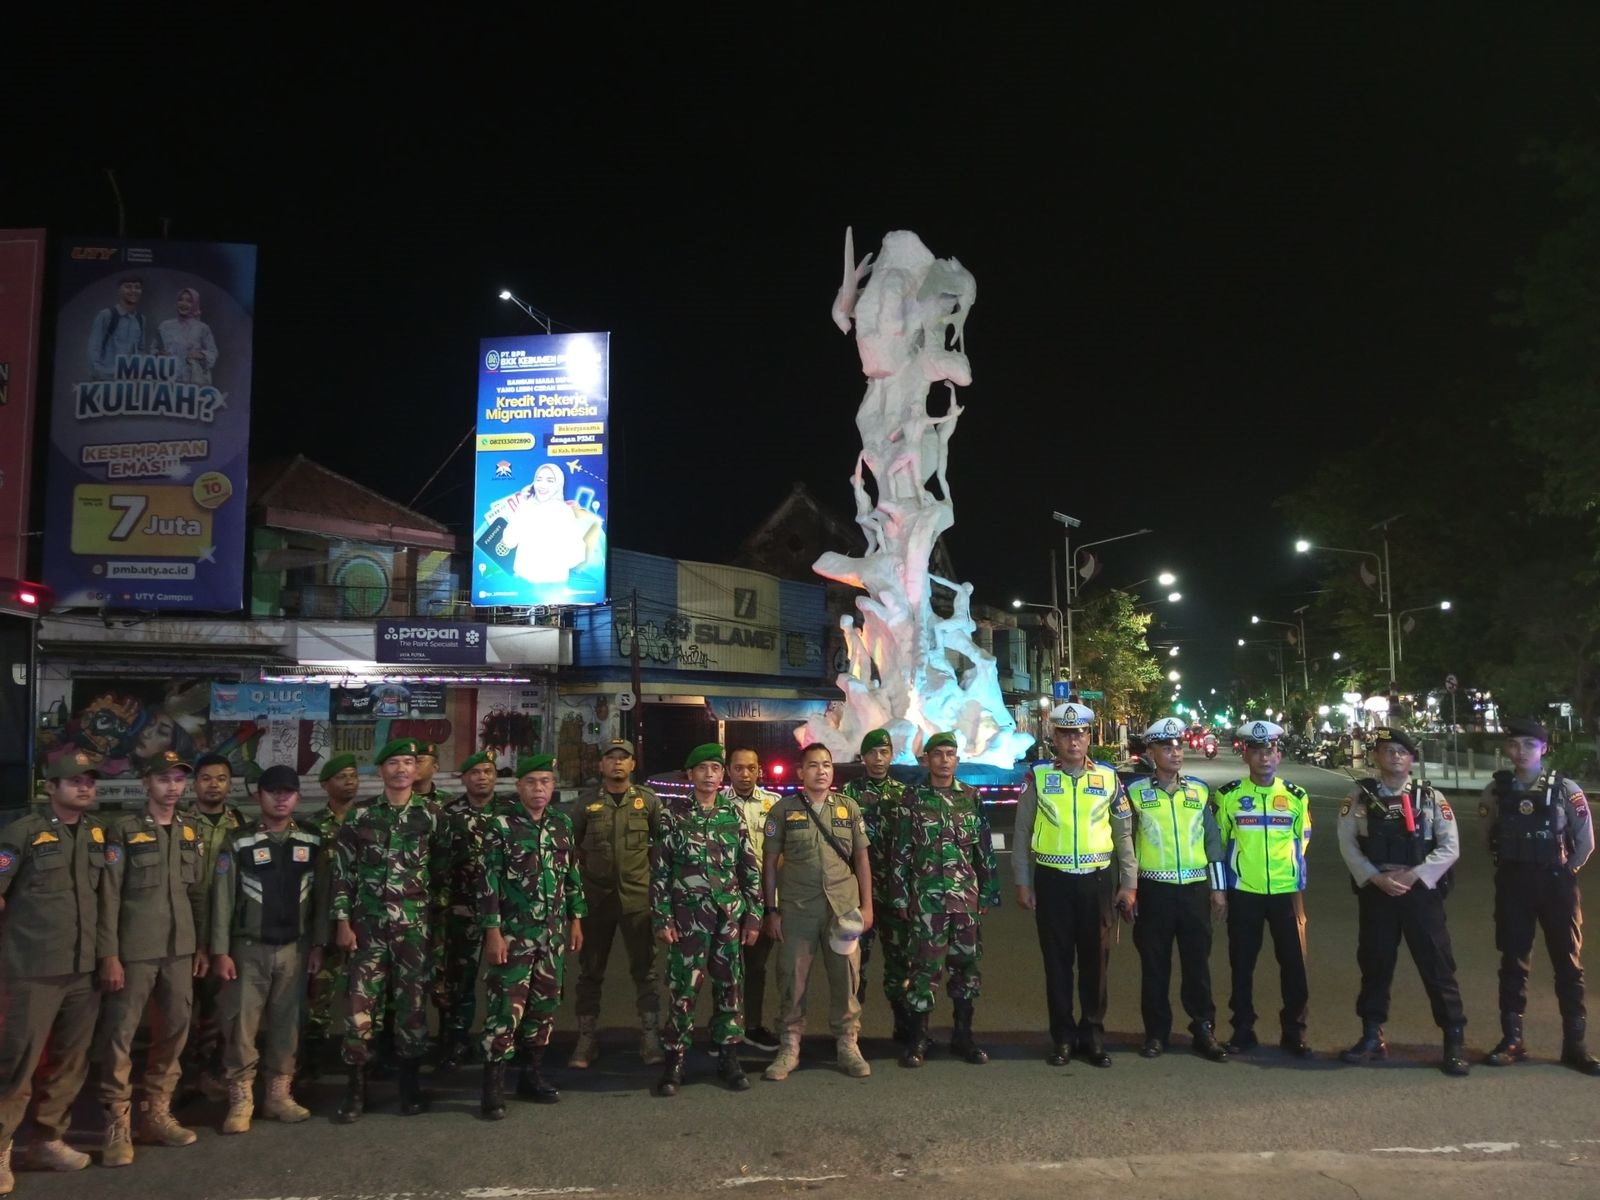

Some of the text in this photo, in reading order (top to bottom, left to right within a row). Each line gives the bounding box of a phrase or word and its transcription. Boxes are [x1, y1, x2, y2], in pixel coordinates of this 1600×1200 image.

[117, 355, 176, 381] MAU
[77, 383, 220, 421] KULIAH?
[496, 392, 589, 409] Kredit Pekerja
[486, 406, 598, 423] Migran Indonesia
[84, 440, 207, 462] KESEMPATAN
[203, 482, 223, 497] 10
[109, 495, 202, 541] 7 Juta
[112, 564, 189, 577] pmb.uty.ac.id
[135, 592, 194, 603] UTY Campus
[399, 627, 460, 641] propan
[694, 622, 778, 651] SLAMET
[400, 640, 459, 649] The Paint Specialist
